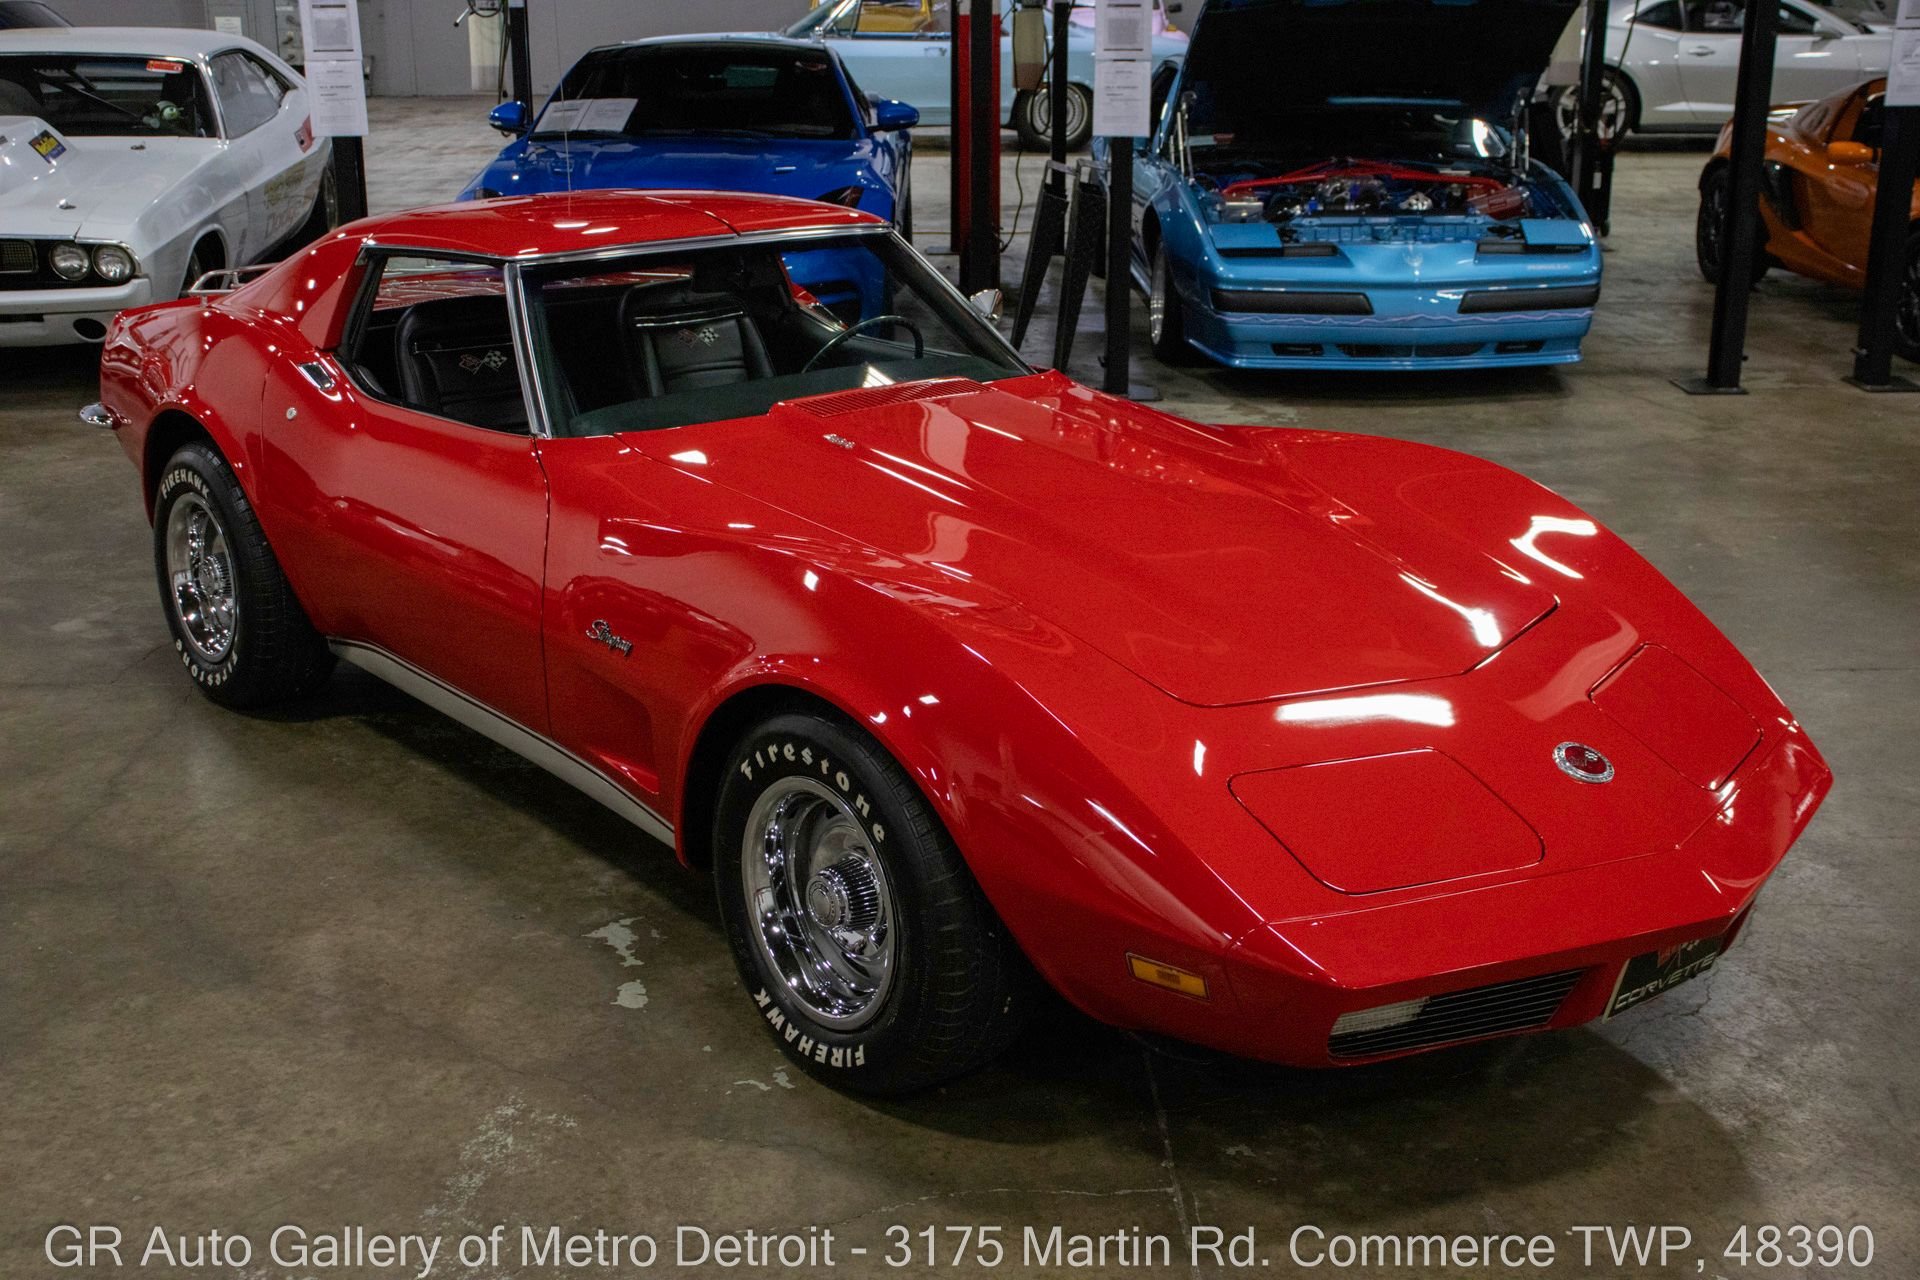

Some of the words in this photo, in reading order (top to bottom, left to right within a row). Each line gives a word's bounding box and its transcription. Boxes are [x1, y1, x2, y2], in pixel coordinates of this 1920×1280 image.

[161, 468, 210, 500] FIREHAWK
[1613, 951, 1718, 1011] CORVETTE
[752, 987, 867, 1069] FIREHAWK
